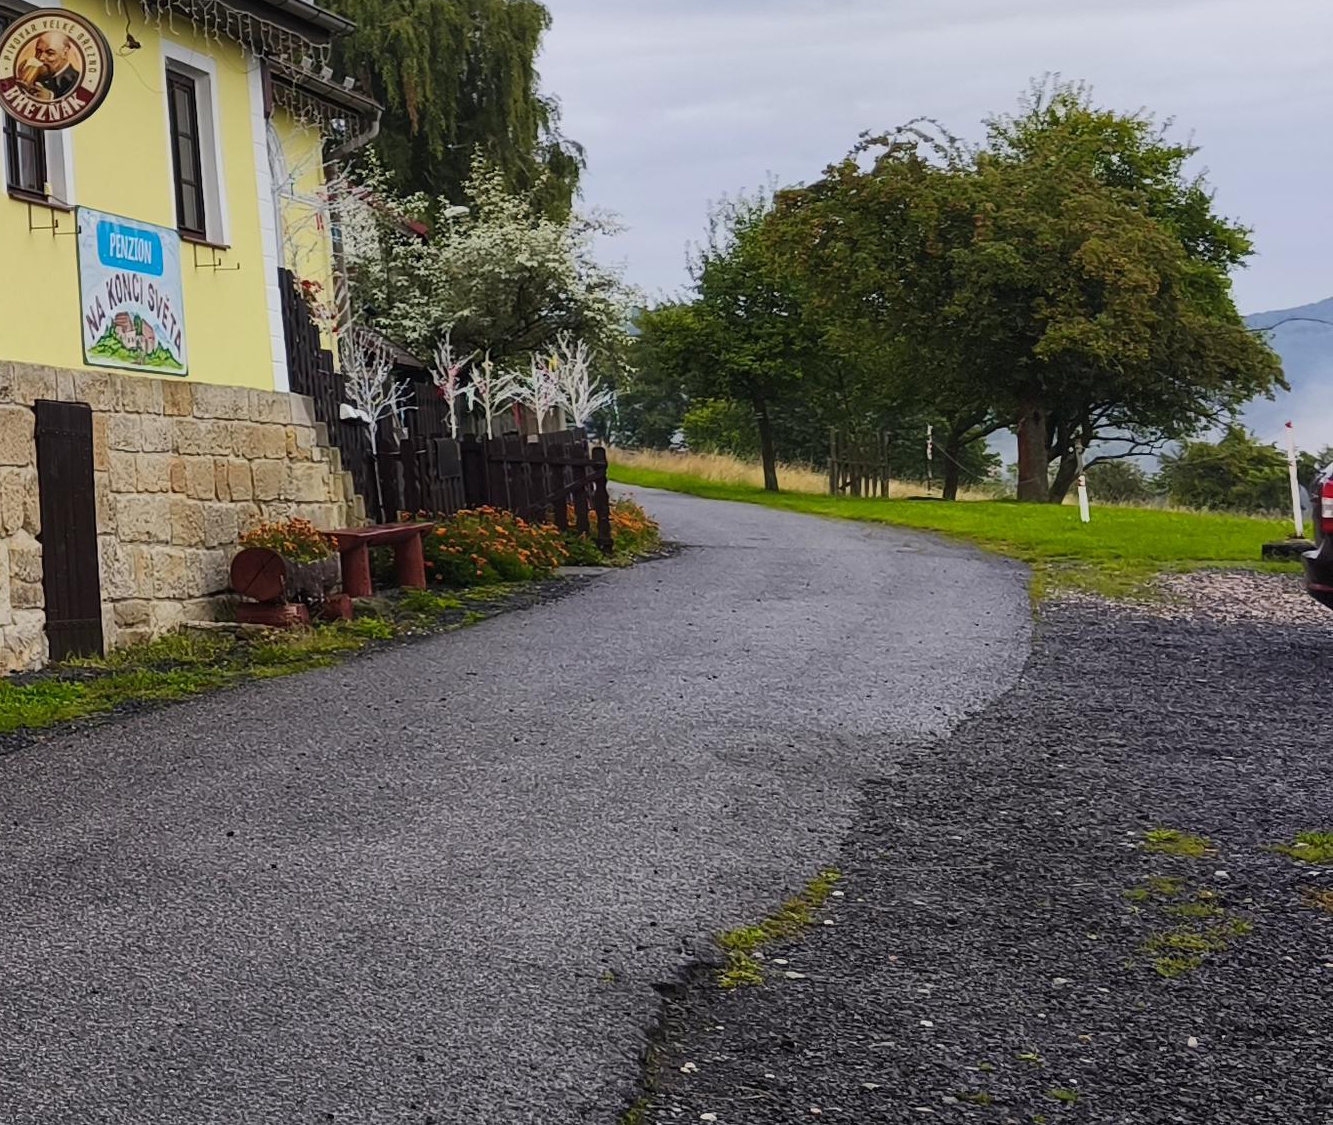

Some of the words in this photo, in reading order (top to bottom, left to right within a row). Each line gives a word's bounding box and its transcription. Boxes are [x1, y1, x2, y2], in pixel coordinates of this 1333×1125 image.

[4, 24, 38, 61] PIVOVAR
[42, 19, 75, 34] VELKÉ
[3, 85, 86, 121] BŘEZŇÁK
[109, 233, 152, 264] PENZION
[86, 296, 105, 340] NA
[106, 273, 143, 311] KONCI
[147, 283, 182, 357] SVĚTA
